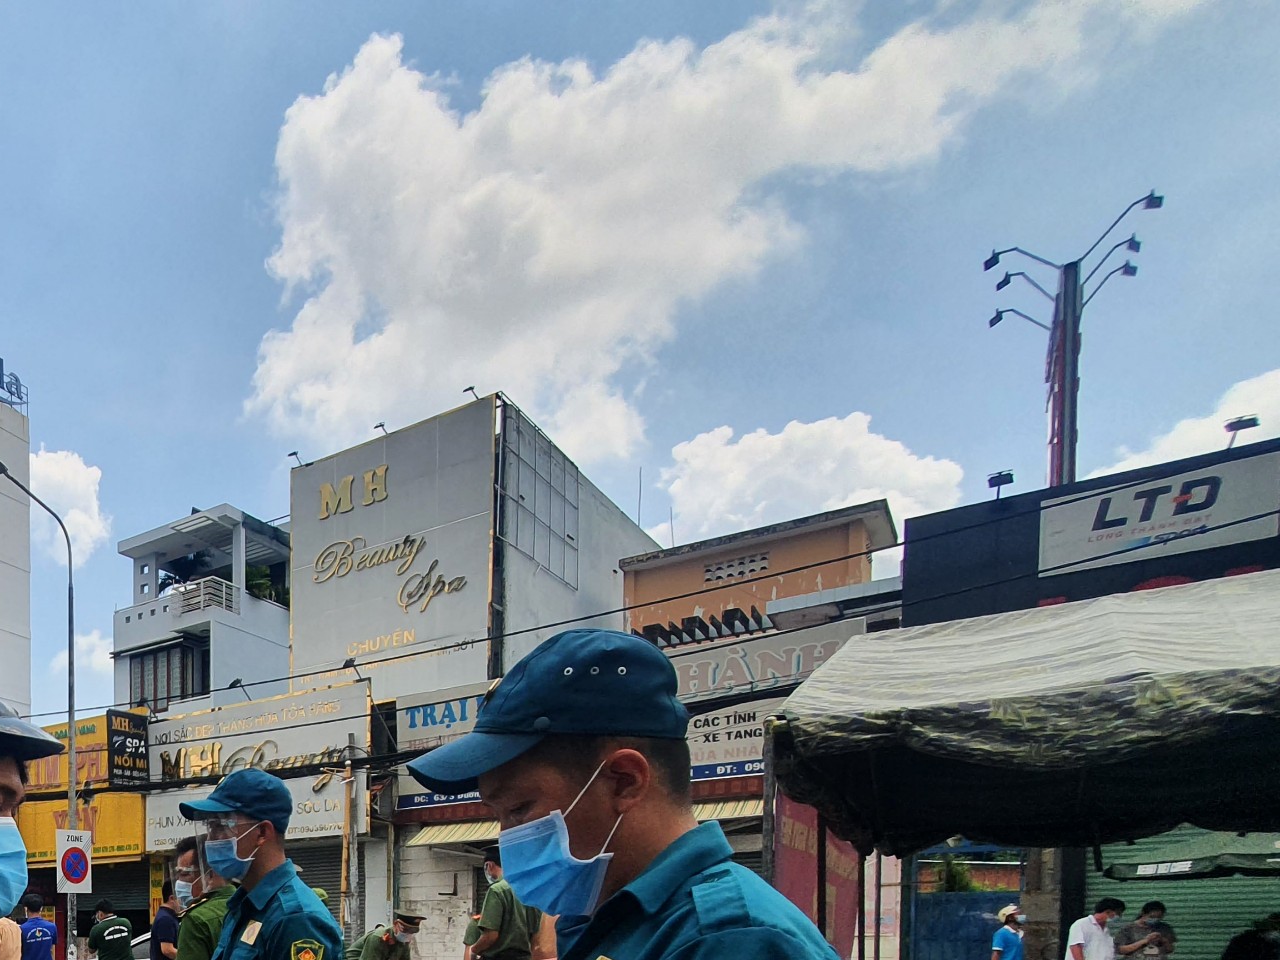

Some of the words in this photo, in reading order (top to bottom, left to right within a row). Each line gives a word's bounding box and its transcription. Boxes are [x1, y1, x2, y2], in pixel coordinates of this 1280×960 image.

[318, 464, 389, 520] MH
[1091, 476, 1223, 531] LTD
[313, 534, 427, 583] Beauty
[397, 559, 468, 613] Spa
[405, 699, 468, 729] TRẠI
[693, 714, 720, 729] CÁC
[724, 711, 756, 725] TỈNH
[112, 716, 130, 732] MH
[703, 733, 720, 743] XE
[725, 728, 763, 741] TANG
[125, 737, 146, 754] SPA
[114, 753, 134, 768] NỐI
[66, 834, 83, 843] ZONE
